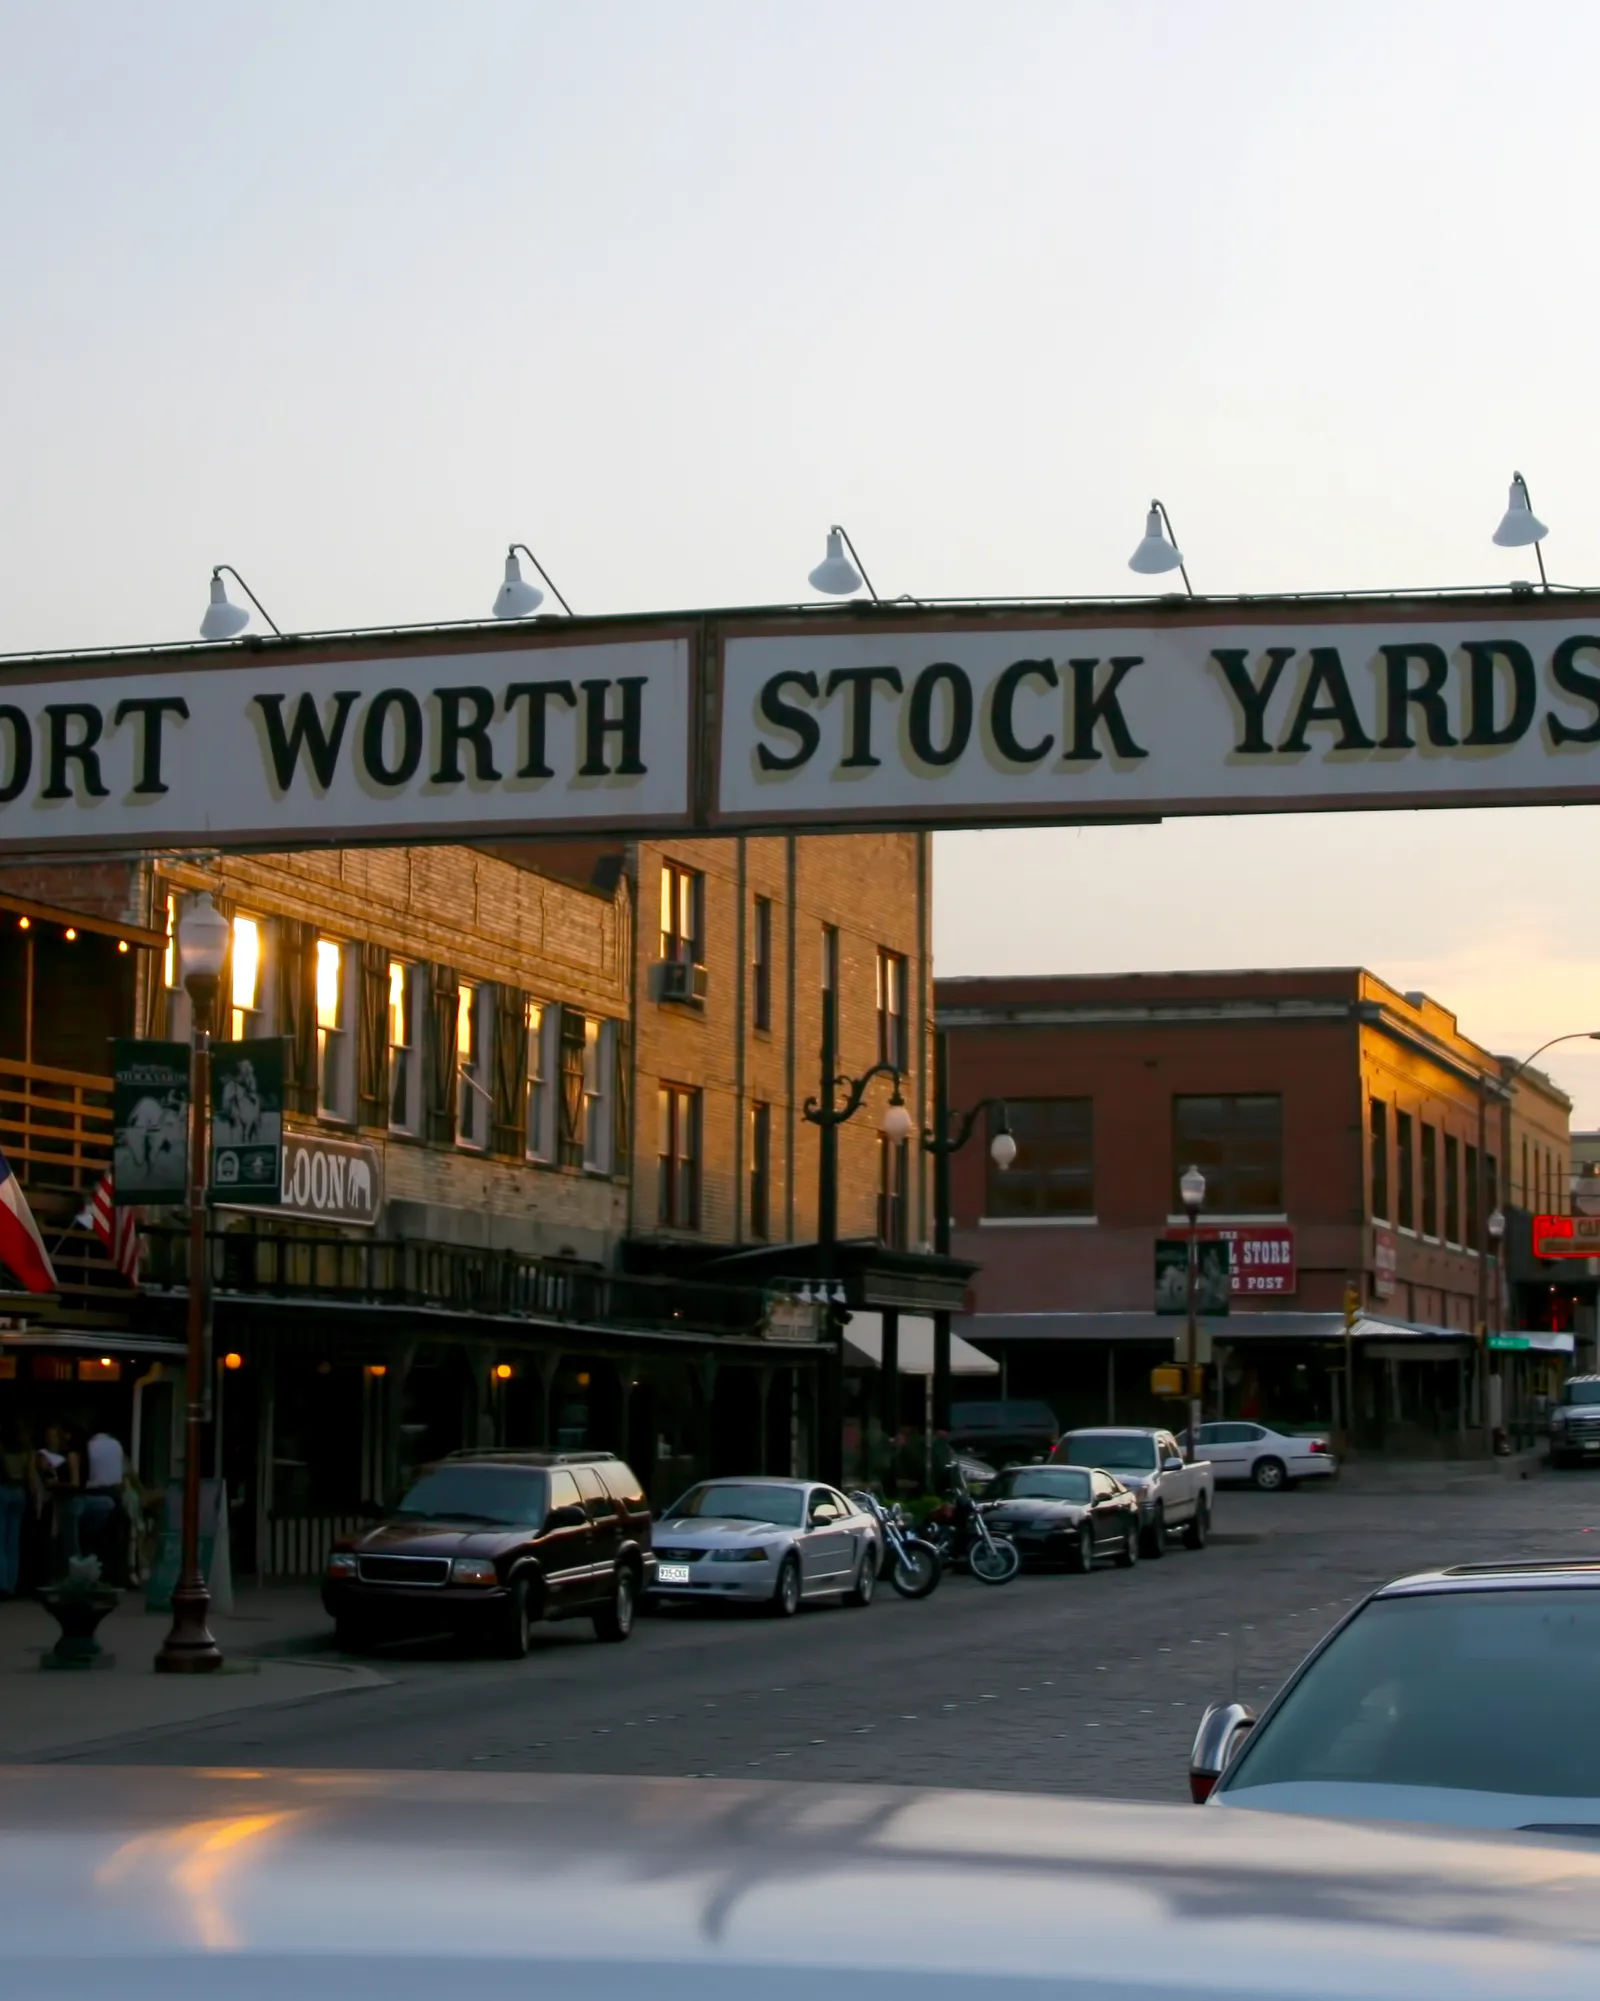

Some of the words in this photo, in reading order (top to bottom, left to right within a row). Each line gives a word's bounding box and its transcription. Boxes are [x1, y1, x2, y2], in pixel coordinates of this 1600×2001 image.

[0, 697, 190, 803] ORT
[253, 677, 648, 791] WORTH
[757, 657, 1149, 771] STOCK
[1210, 634, 1600, 754] YARDS
[1244, 1241, 1290, 1264] STORE
[1248, 1277, 1284, 1289] POST
